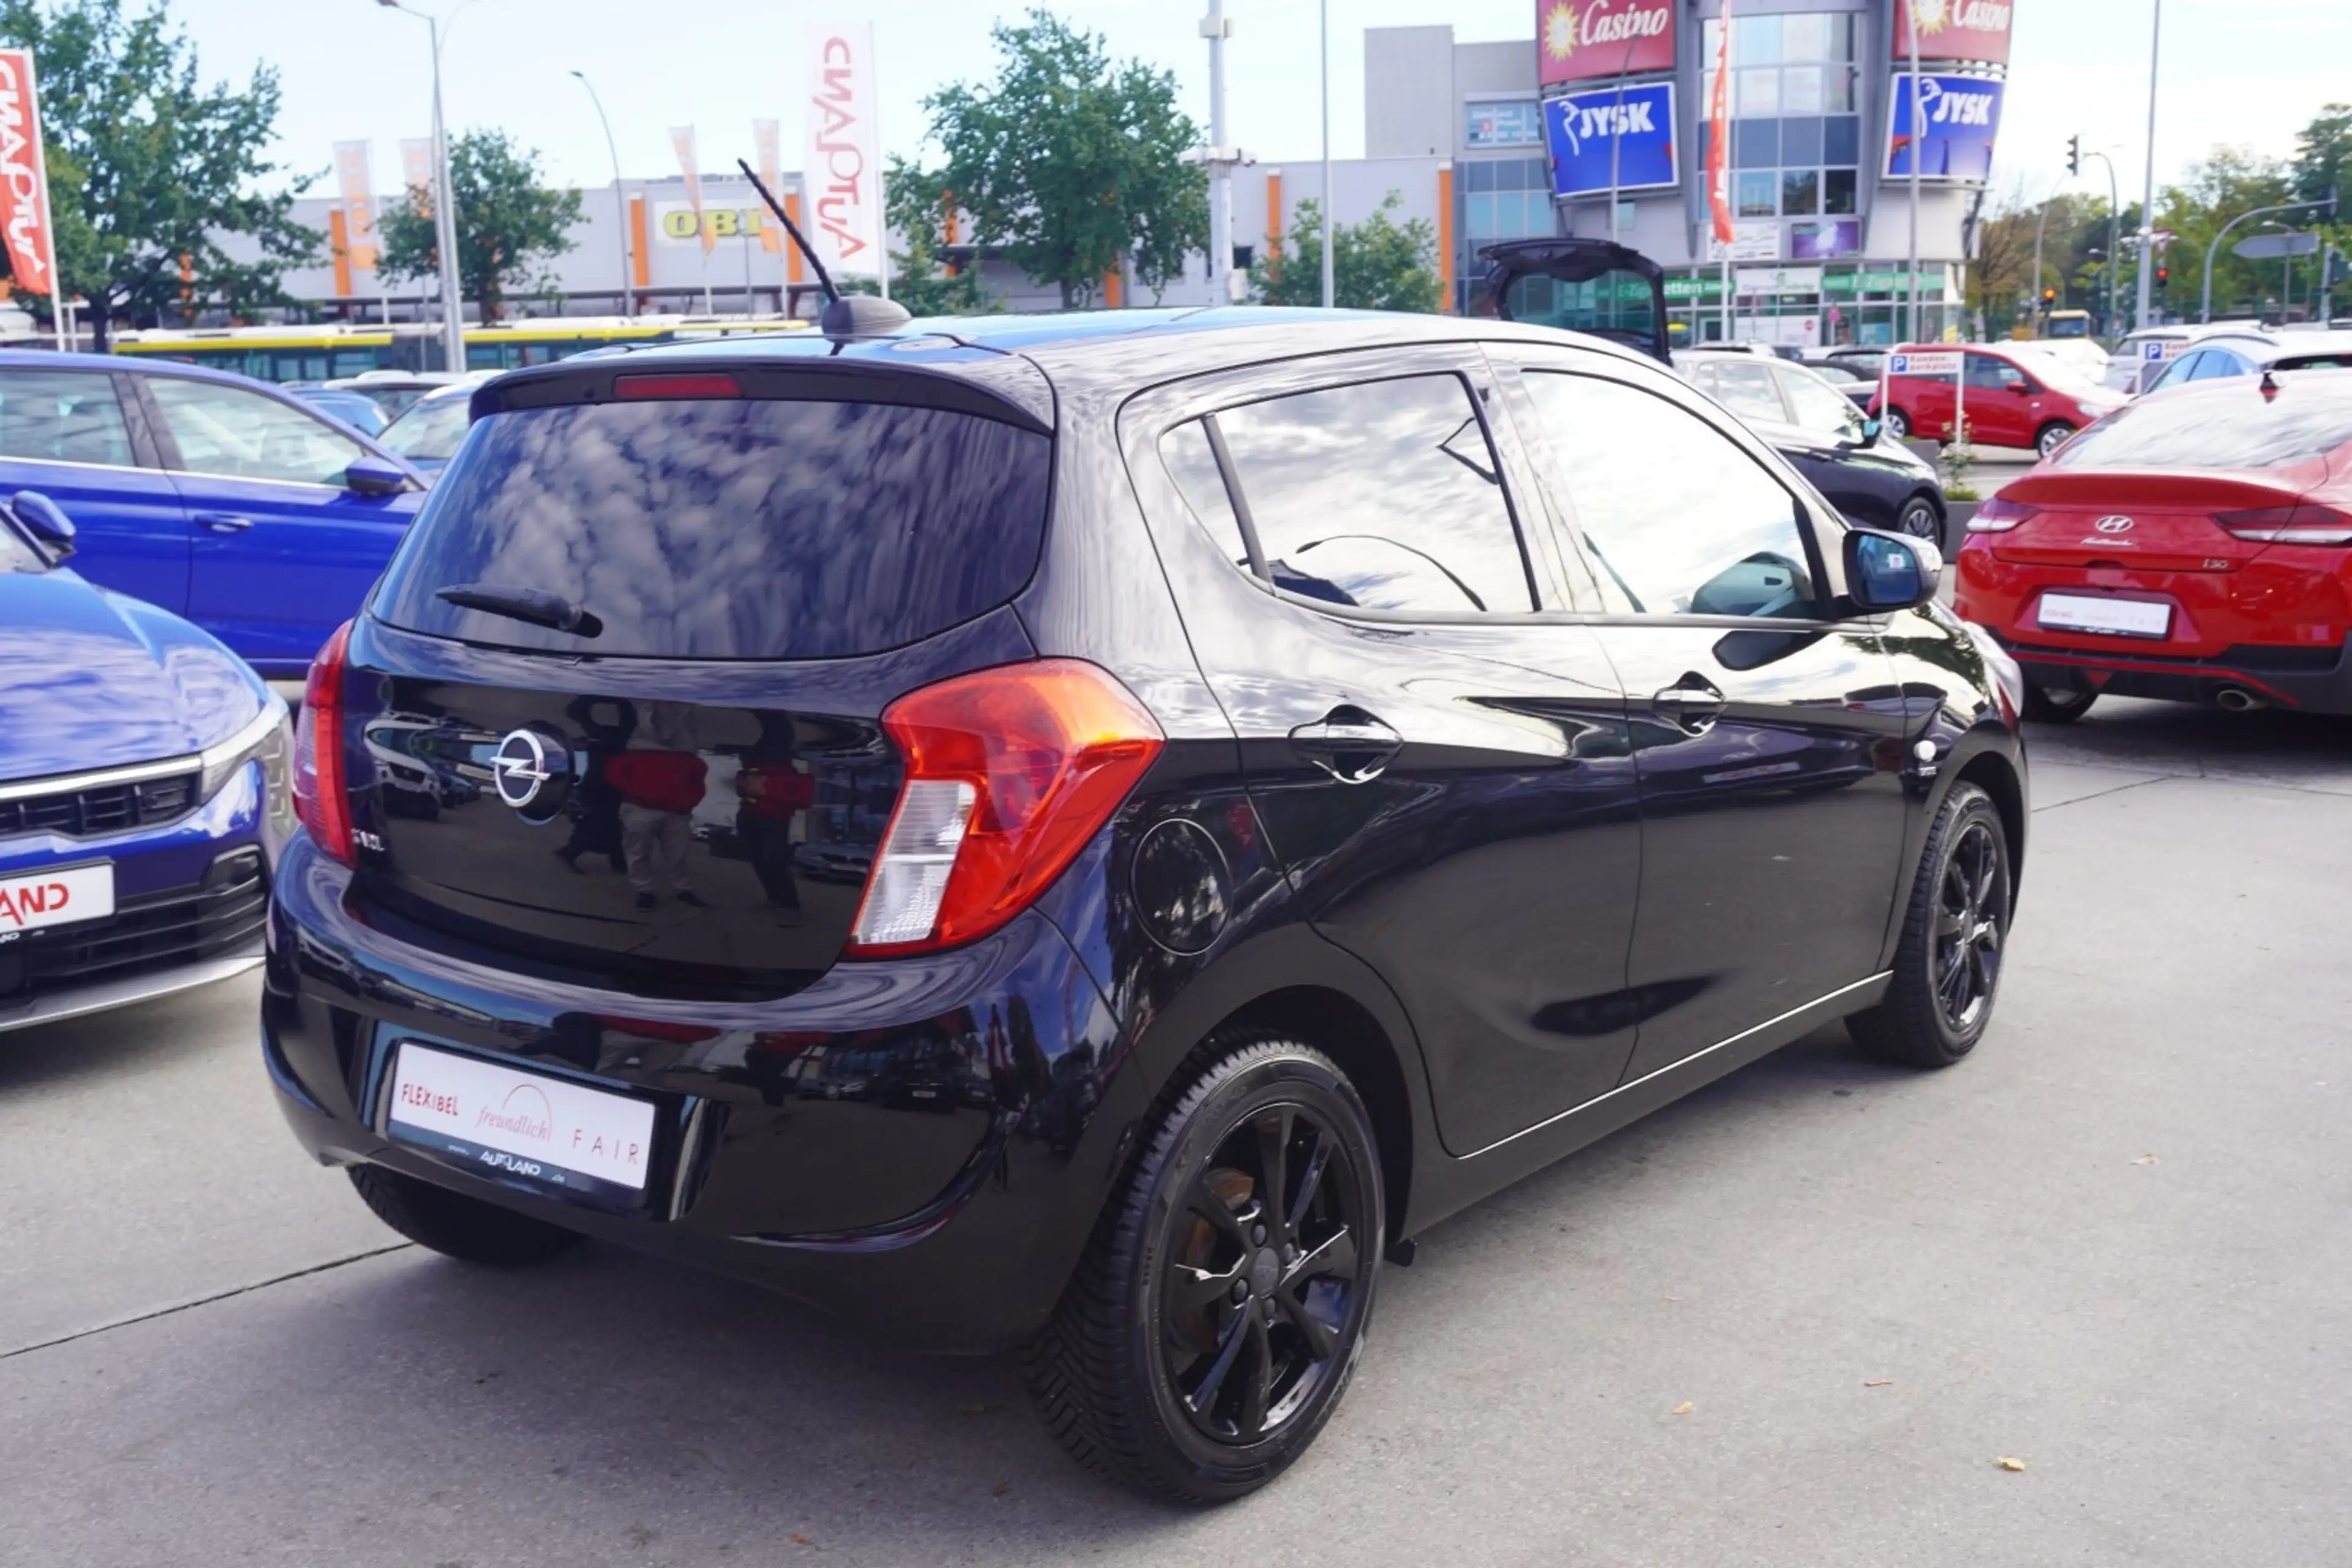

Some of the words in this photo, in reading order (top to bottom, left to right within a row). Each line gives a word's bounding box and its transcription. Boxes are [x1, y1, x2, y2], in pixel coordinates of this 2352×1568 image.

[1580, 0, 1668, 46] Casino
[1580, 101, 1656, 139] JYSK
[1932, 92, 1994, 125] JYSK
[663, 209, 761, 237] OBI
[401, 1084, 459, 1116] FLEXIBEL
[475, 1105, 550, 1140] freundlich
